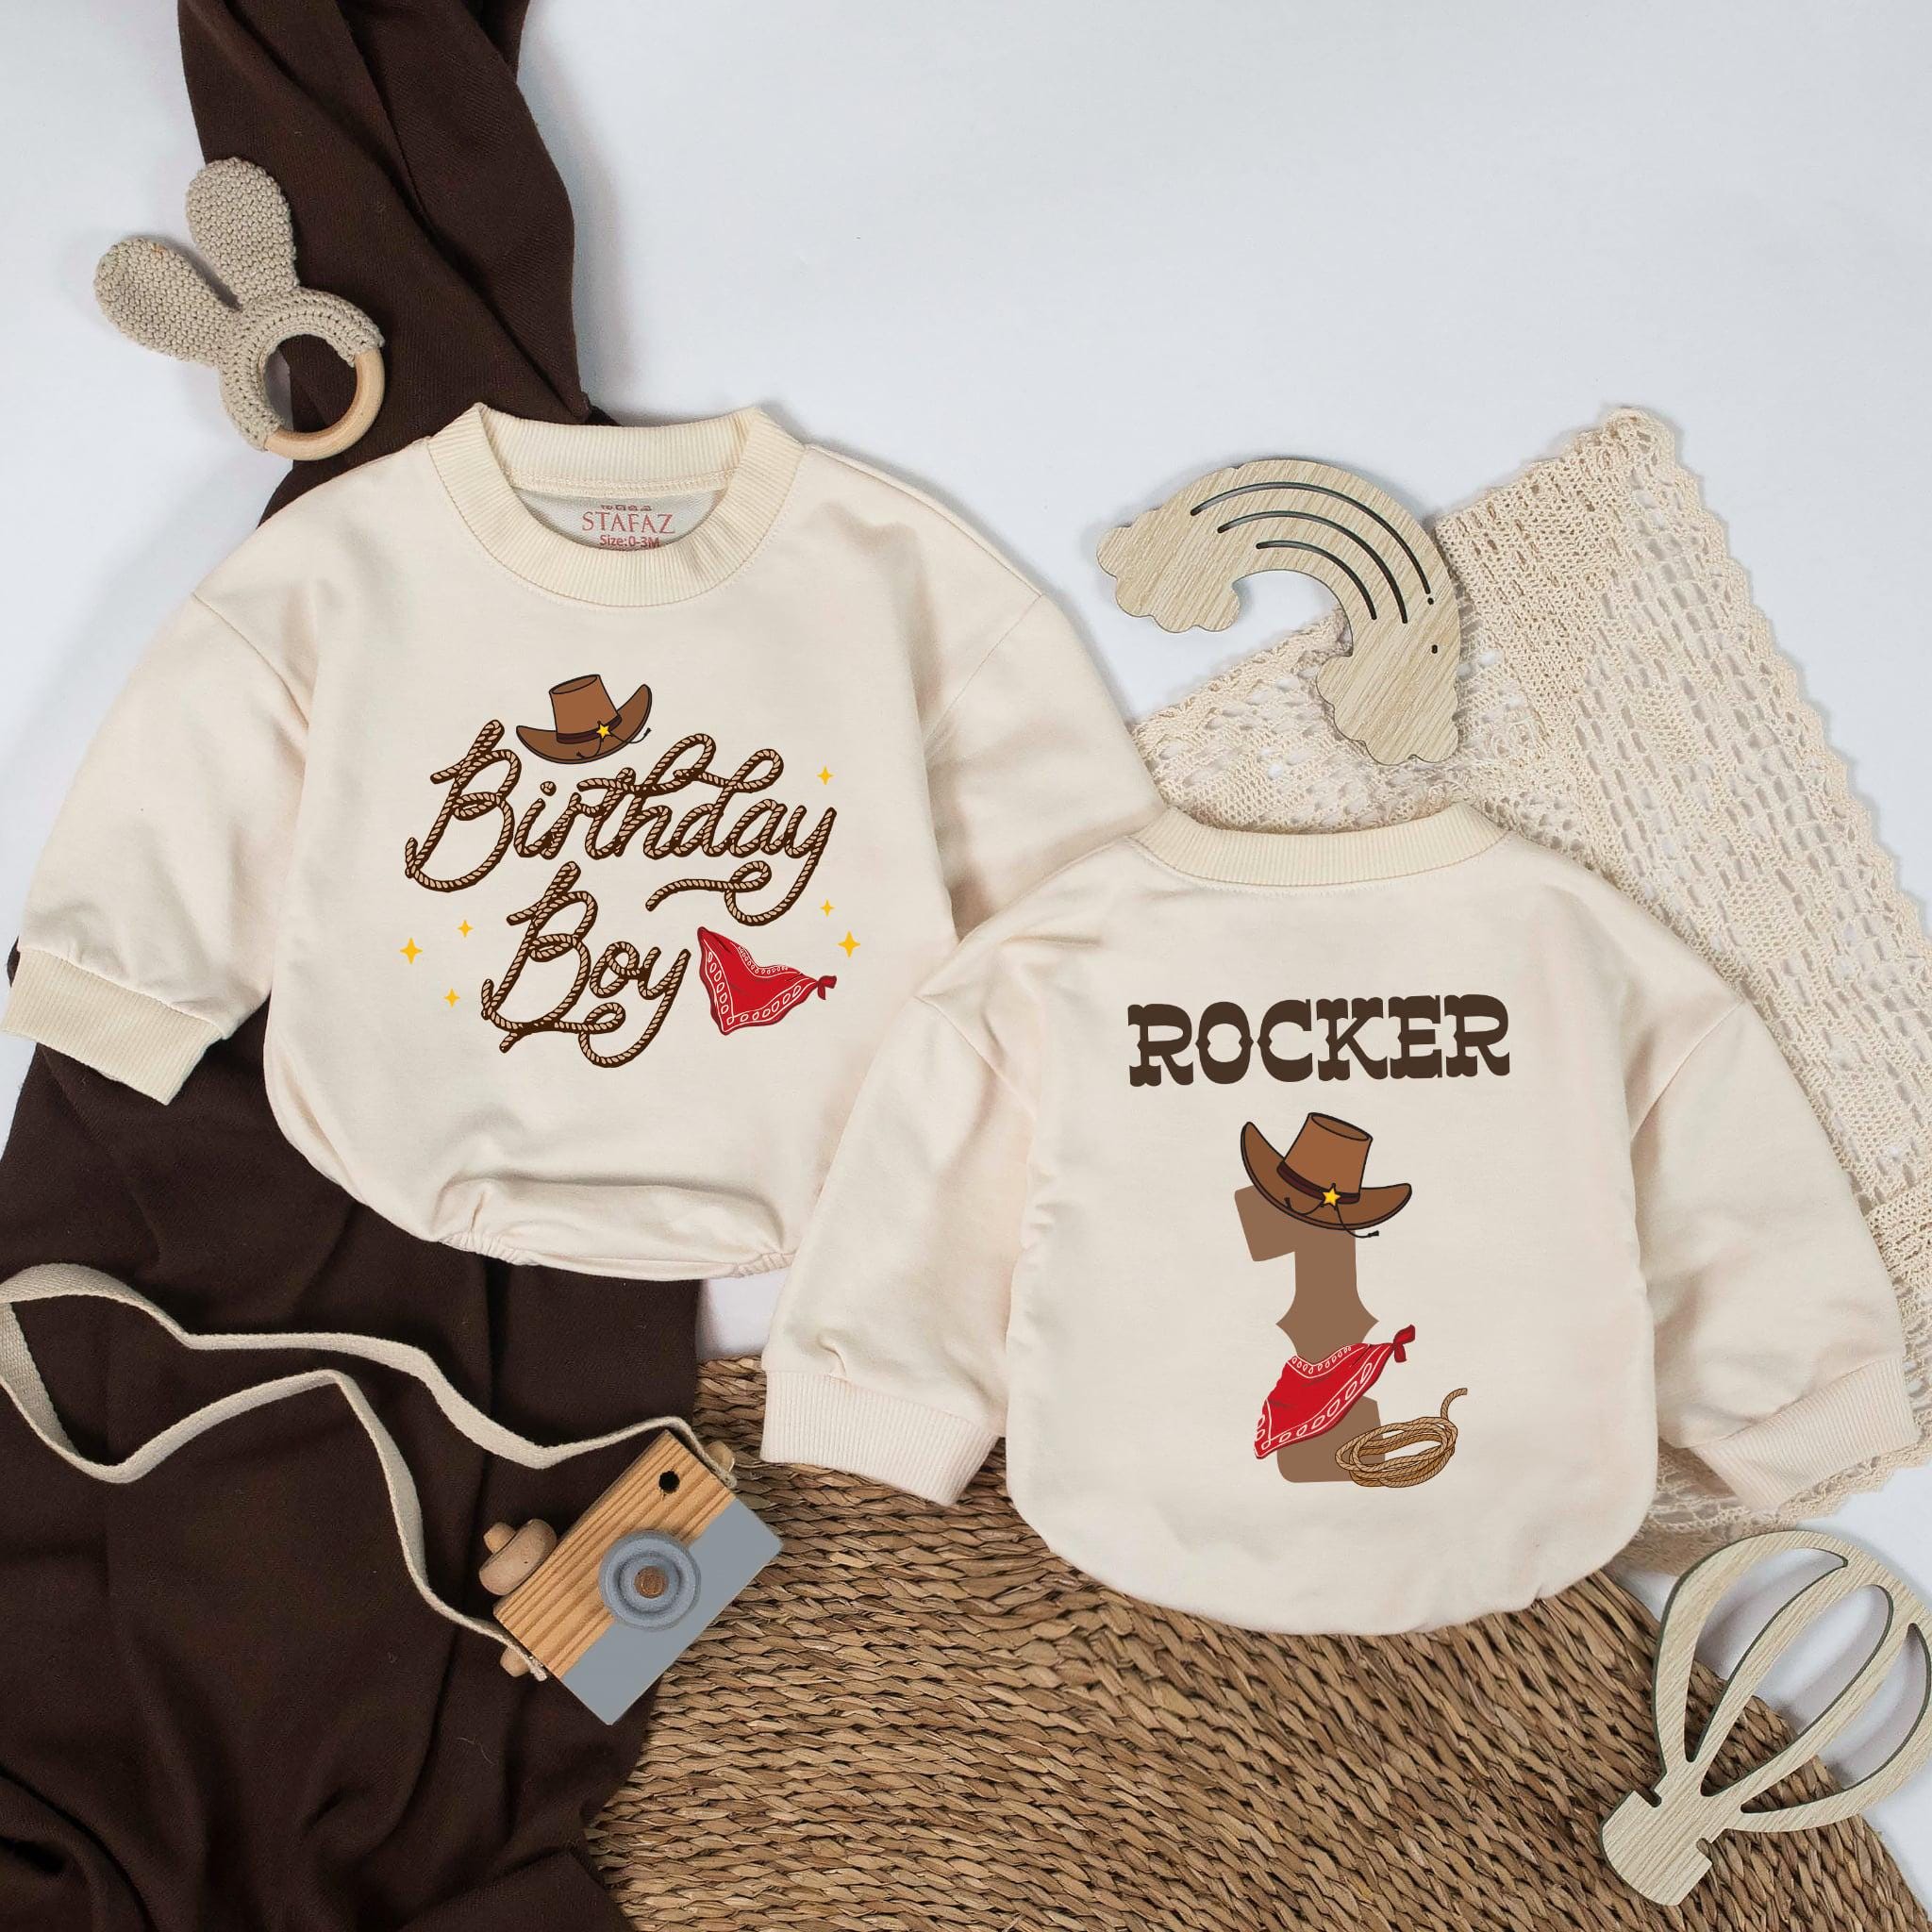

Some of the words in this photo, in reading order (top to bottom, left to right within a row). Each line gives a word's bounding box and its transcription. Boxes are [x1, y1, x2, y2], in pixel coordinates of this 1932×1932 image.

[582, 511, 675, 534] STAFAZ
[405, 719, 837, 926] Birthday
[480, 861, 691, 1069] Boy
[1127, 993, 1510, 1087] ROCKER
